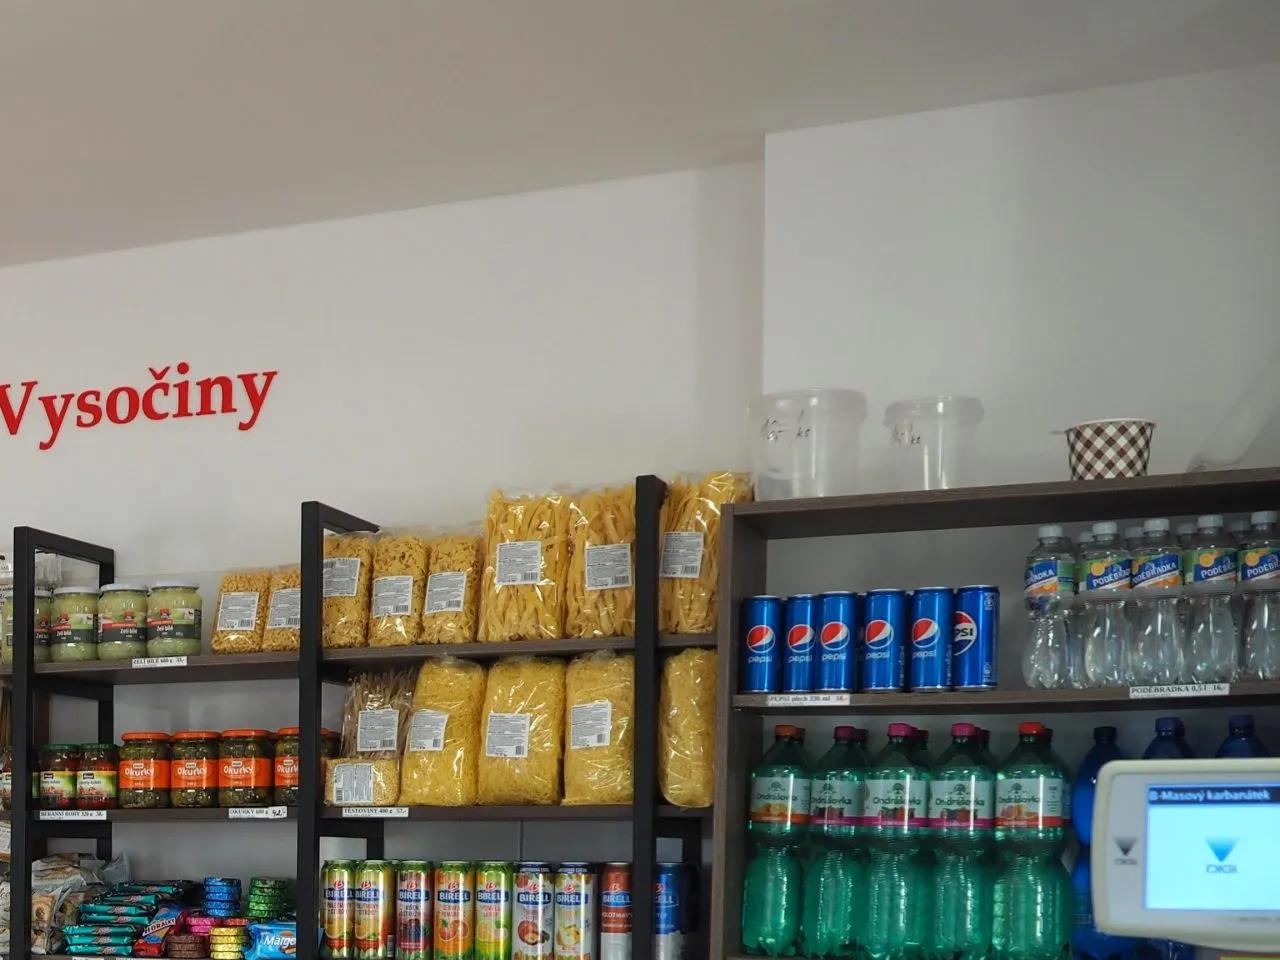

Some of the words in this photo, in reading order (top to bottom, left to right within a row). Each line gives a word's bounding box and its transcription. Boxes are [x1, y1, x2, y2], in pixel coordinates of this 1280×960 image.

[748, 653, 773, 665] pepsi
[788, 653, 813, 664] pepsi
[821, 651, 847, 662] pepsi
[865, 650, 889, 661] pepsi
[912, 649, 936, 661] pepsi
[124, 766, 153, 777] Okurky
[177, 766, 207, 777] Okurky
[223, 765, 254, 776] Okurky
[325, 890, 354, 899] BIRELL
[355, 890, 384, 899] BIRELL
[399, 890, 428, 900] BIRELL
[439, 891, 469, 900] BIRELL
[477, 891, 508, 901] BIRELL
[519, 894, 549, 902] BIRELL
[556, 893, 585, 903] BIRELL
[602, 894, 630, 903] BIRELL
